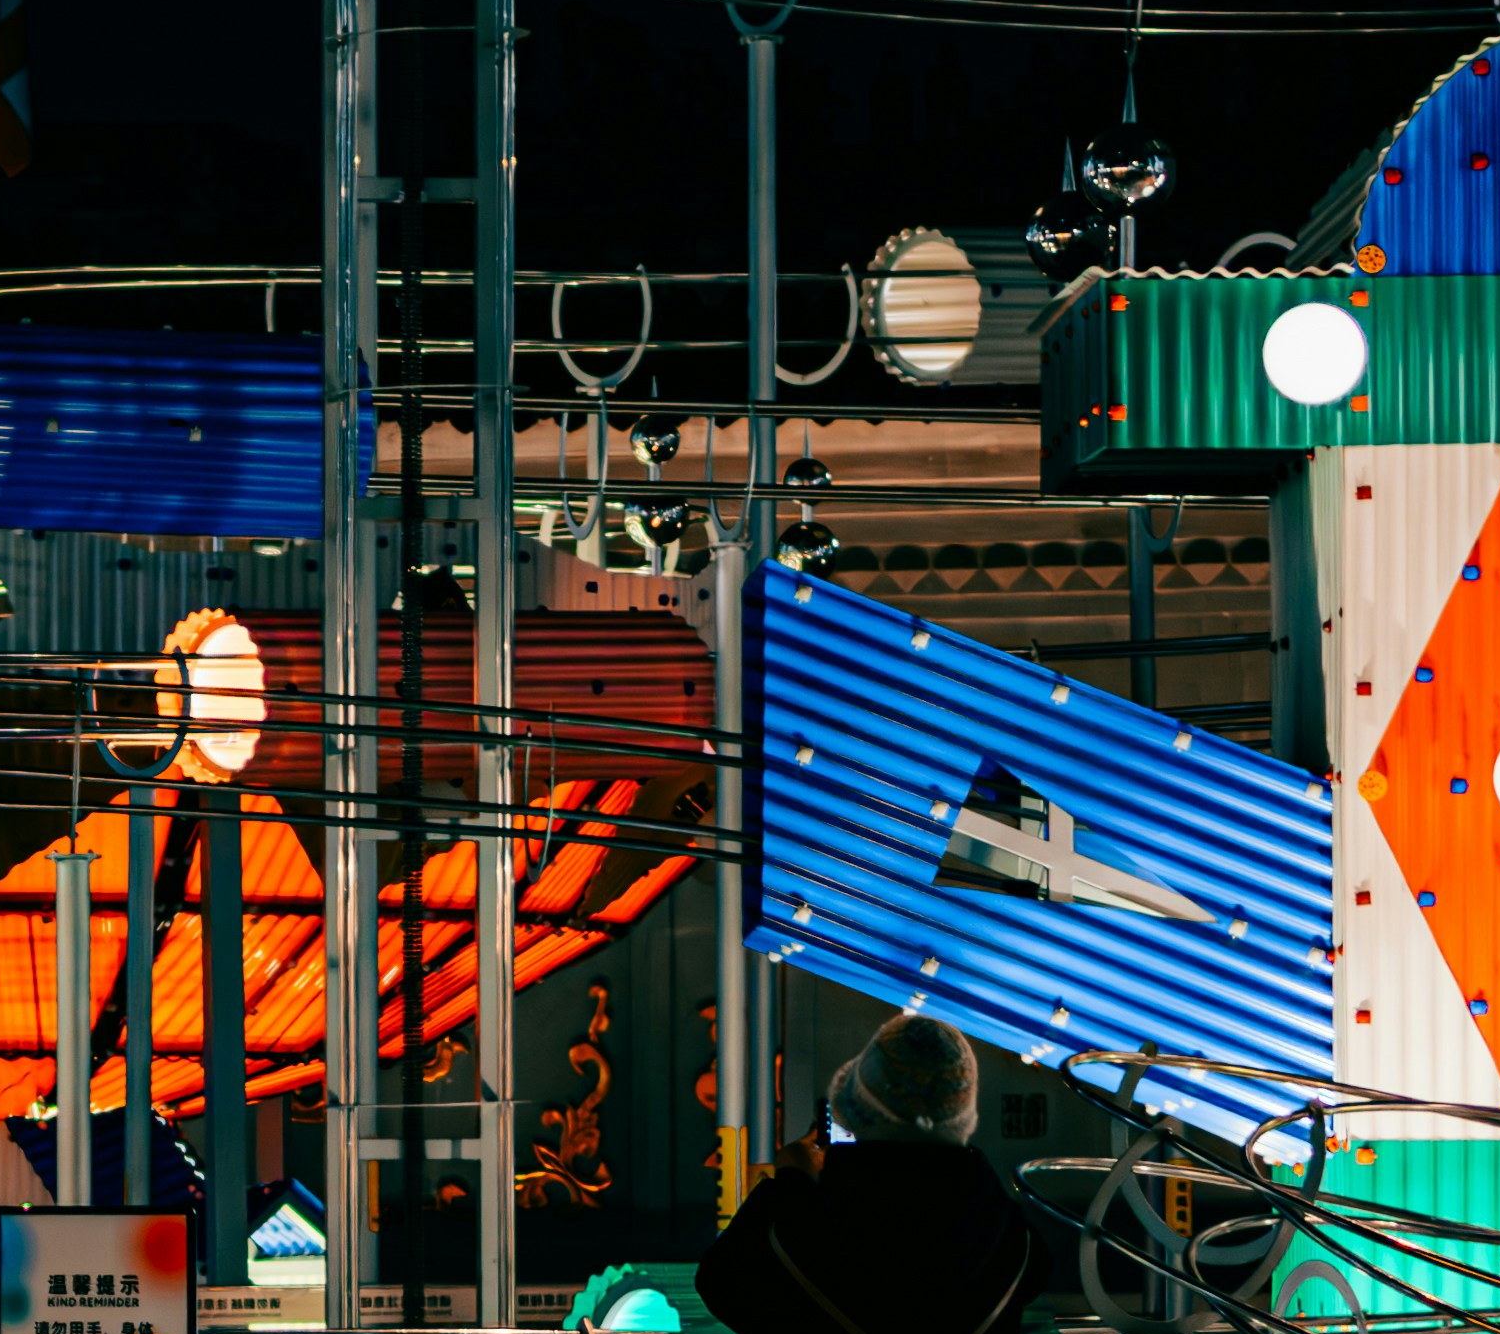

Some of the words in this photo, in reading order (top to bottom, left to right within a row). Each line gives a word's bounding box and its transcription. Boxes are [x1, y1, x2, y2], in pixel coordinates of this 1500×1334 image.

[48, 1274, 140, 1295] 温馨提示
[47, 1297, 77, 1308] KIND
[79, 1297, 140, 1308] REMINDER
